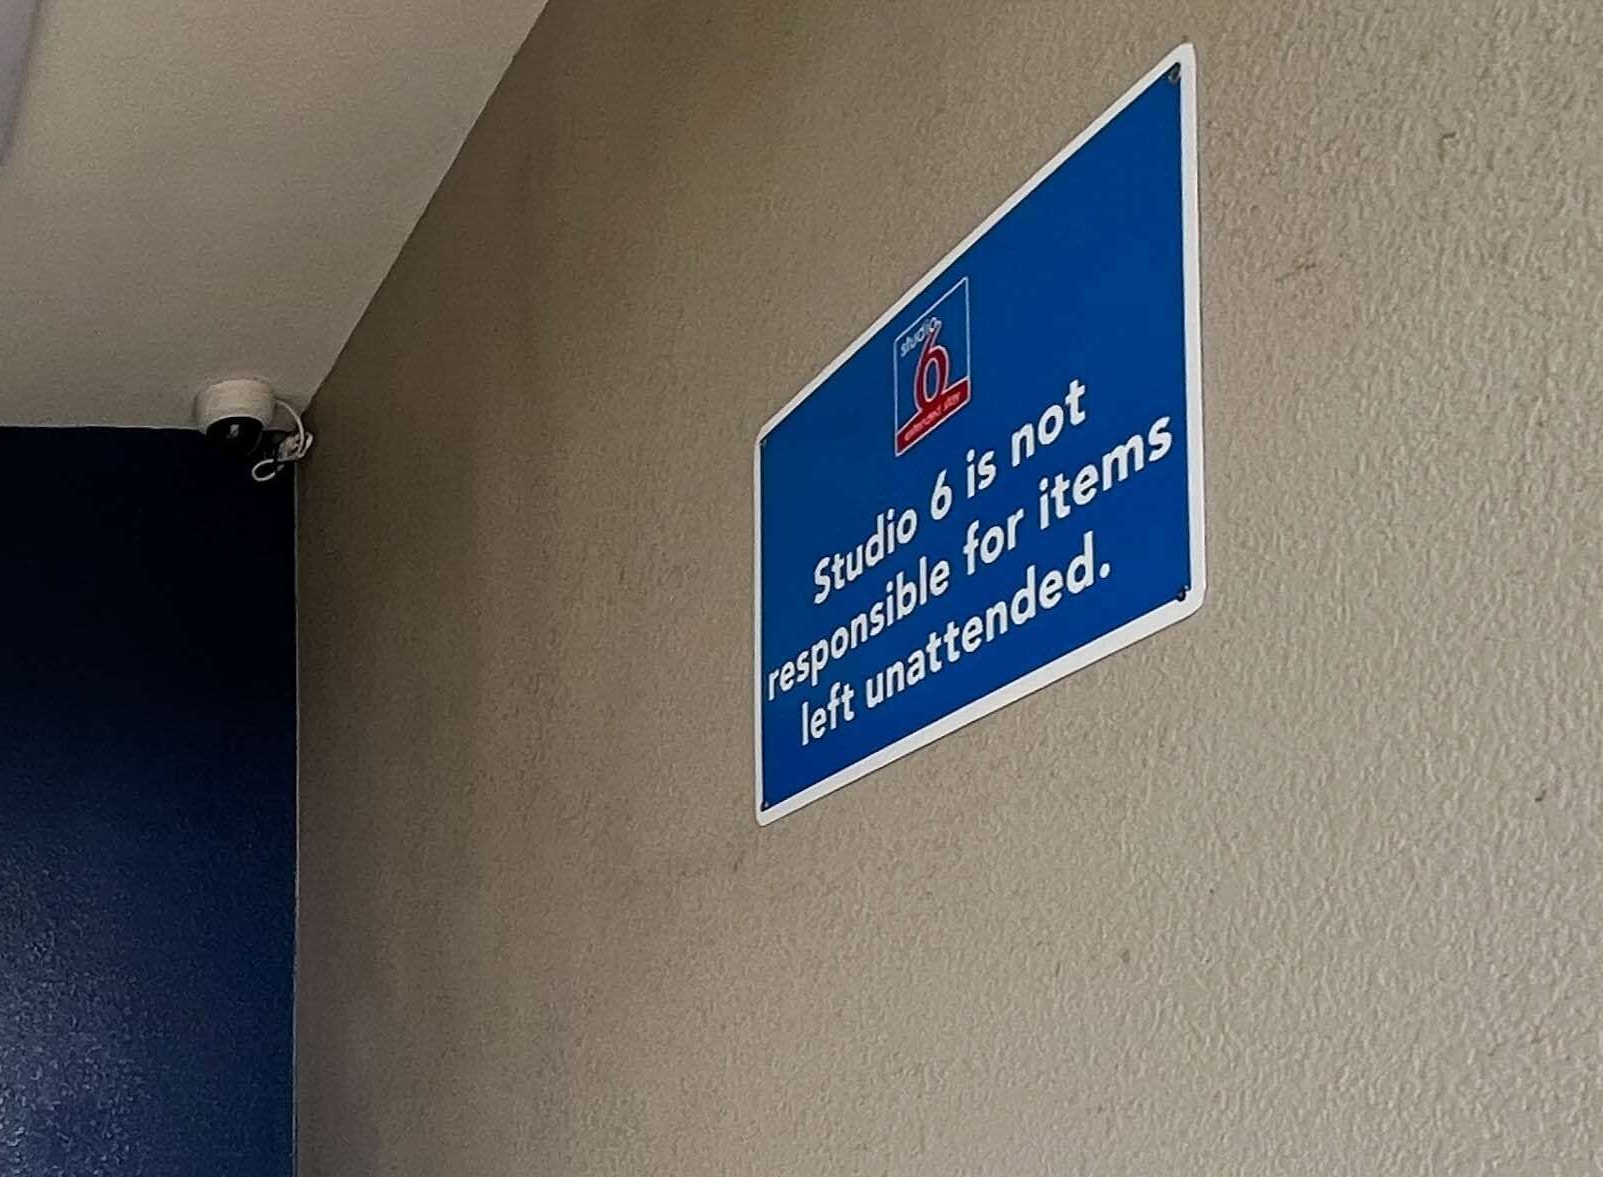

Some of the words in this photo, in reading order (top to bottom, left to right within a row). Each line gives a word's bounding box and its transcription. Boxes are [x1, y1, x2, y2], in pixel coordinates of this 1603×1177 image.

[768, 555, 949, 700] responsible
[963, 508, 1025, 576] for
[1039, 416, 1172, 530] items
[813, 508, 917, 604] Studio
[930, 470, 952, 521] 6
[966, 449, 996, 498] is
[1011, 379, 1087, 467] not
[801, 680, 855, 746] left
[865, 531, 1112, 709] unattended.
